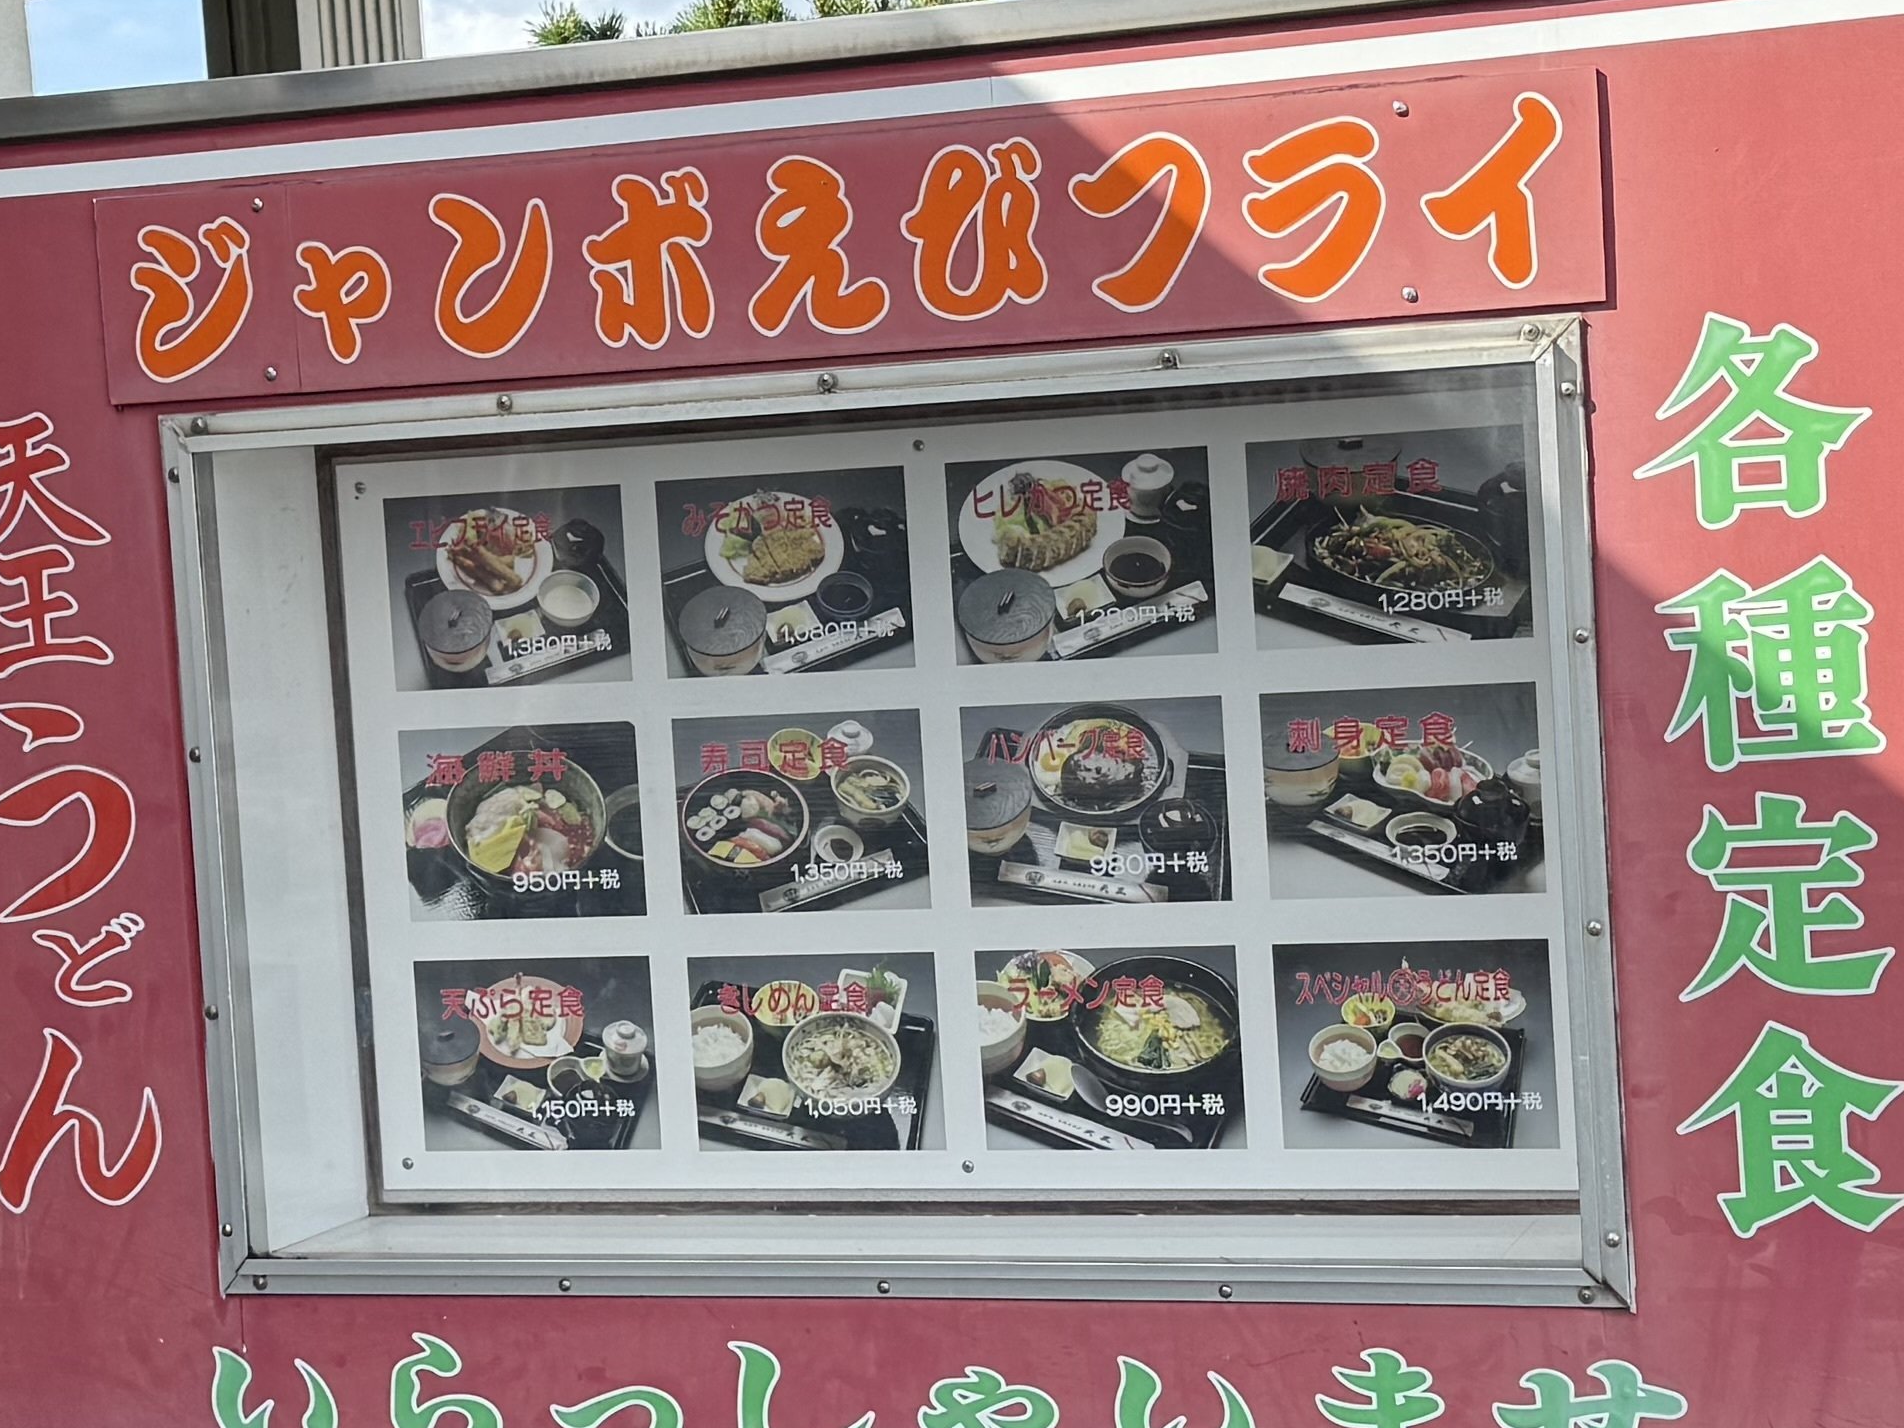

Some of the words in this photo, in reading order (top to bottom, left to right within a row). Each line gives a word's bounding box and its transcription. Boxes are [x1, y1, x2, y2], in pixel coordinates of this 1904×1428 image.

[132, 91, 1563, 382] ジャンボえびフライ
[1286, 710, 1455, 754] 刺身定食
[426, 747, 568, 787] 海鮮丼
[701, 736, 849, 778] 寿司定食
[513, 868, 621, 893] 950円+税
[440, 985, 584, 1021] 天ぷら定食
[716, 980, 873, 1017] きしめん定食
[1007, 974, 1166, 1013] ラーメン定食
[1105, 1092, 1225, 1117] 990円+税
